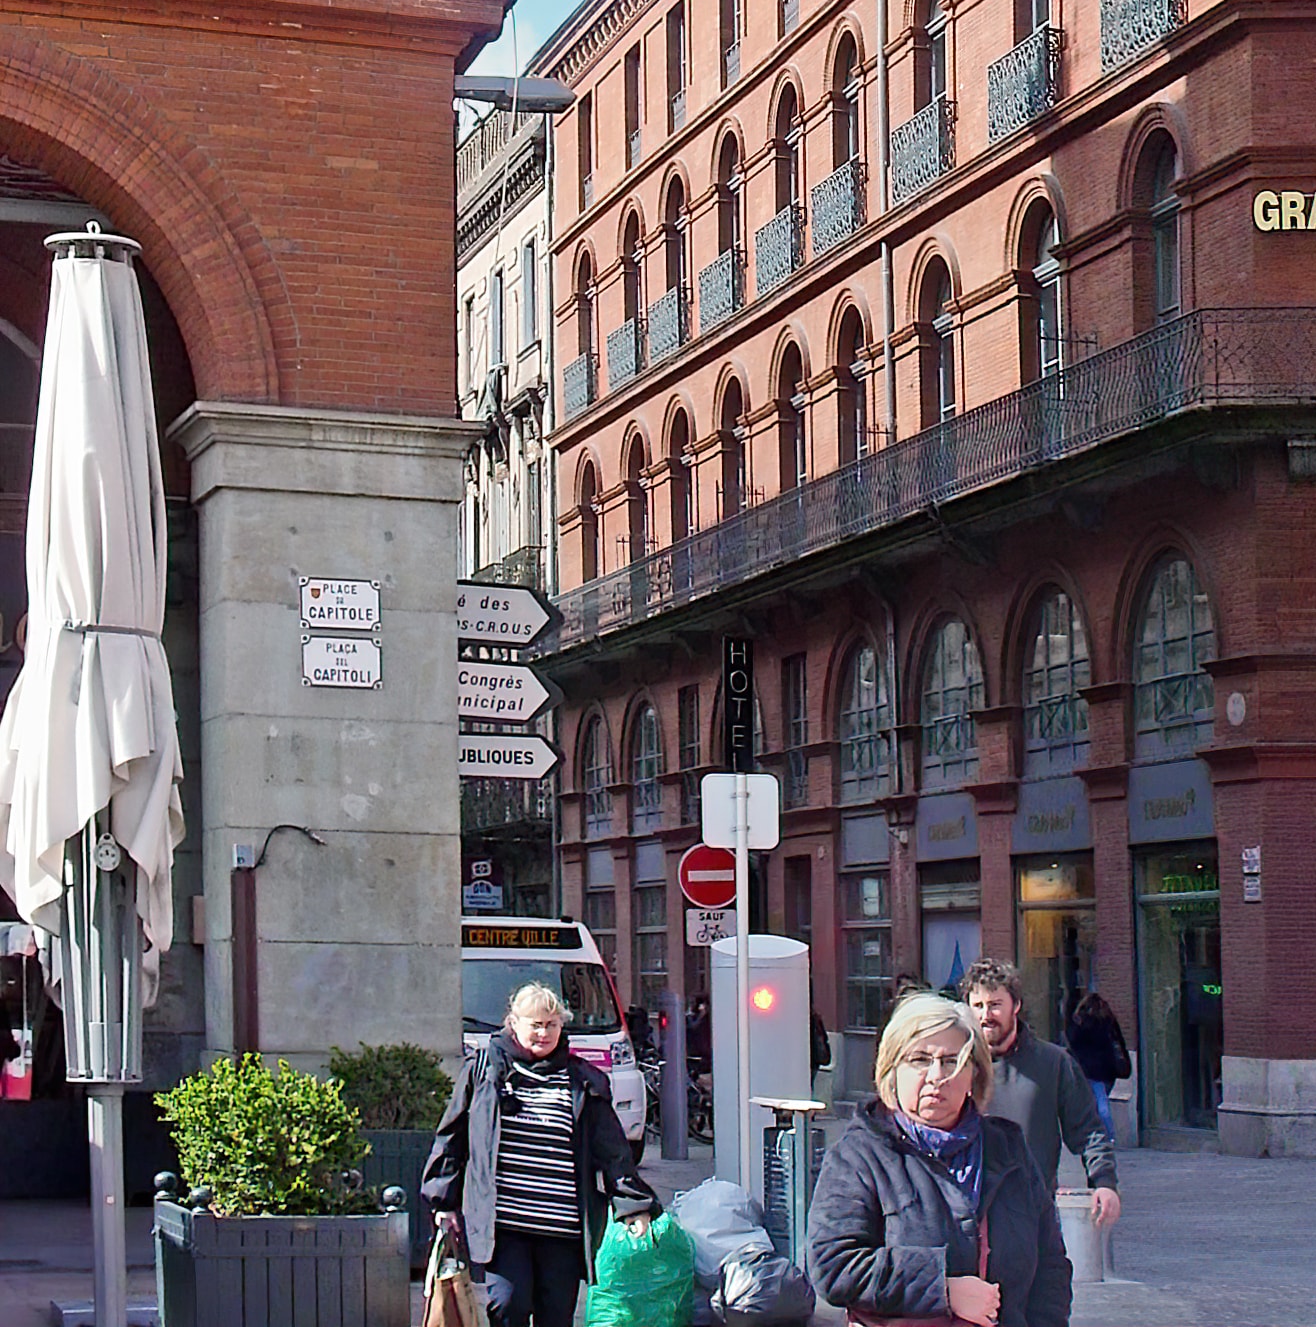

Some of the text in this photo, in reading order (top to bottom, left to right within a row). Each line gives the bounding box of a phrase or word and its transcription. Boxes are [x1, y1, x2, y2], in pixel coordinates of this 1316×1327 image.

[323, 583, 358, 595] PLACE
[480, 596, 510, 611] des
[309, 606, 374, 620] CAPITOLE
[326, 643, 358, 654] PLAÇA
[314, 669, 371, 683] CAPITOLI
[458, 671, 523, 691] Congrès
[699, 912, 725, 921] SAUF
[469, 929, 560, 946] CENTRE VILLE
